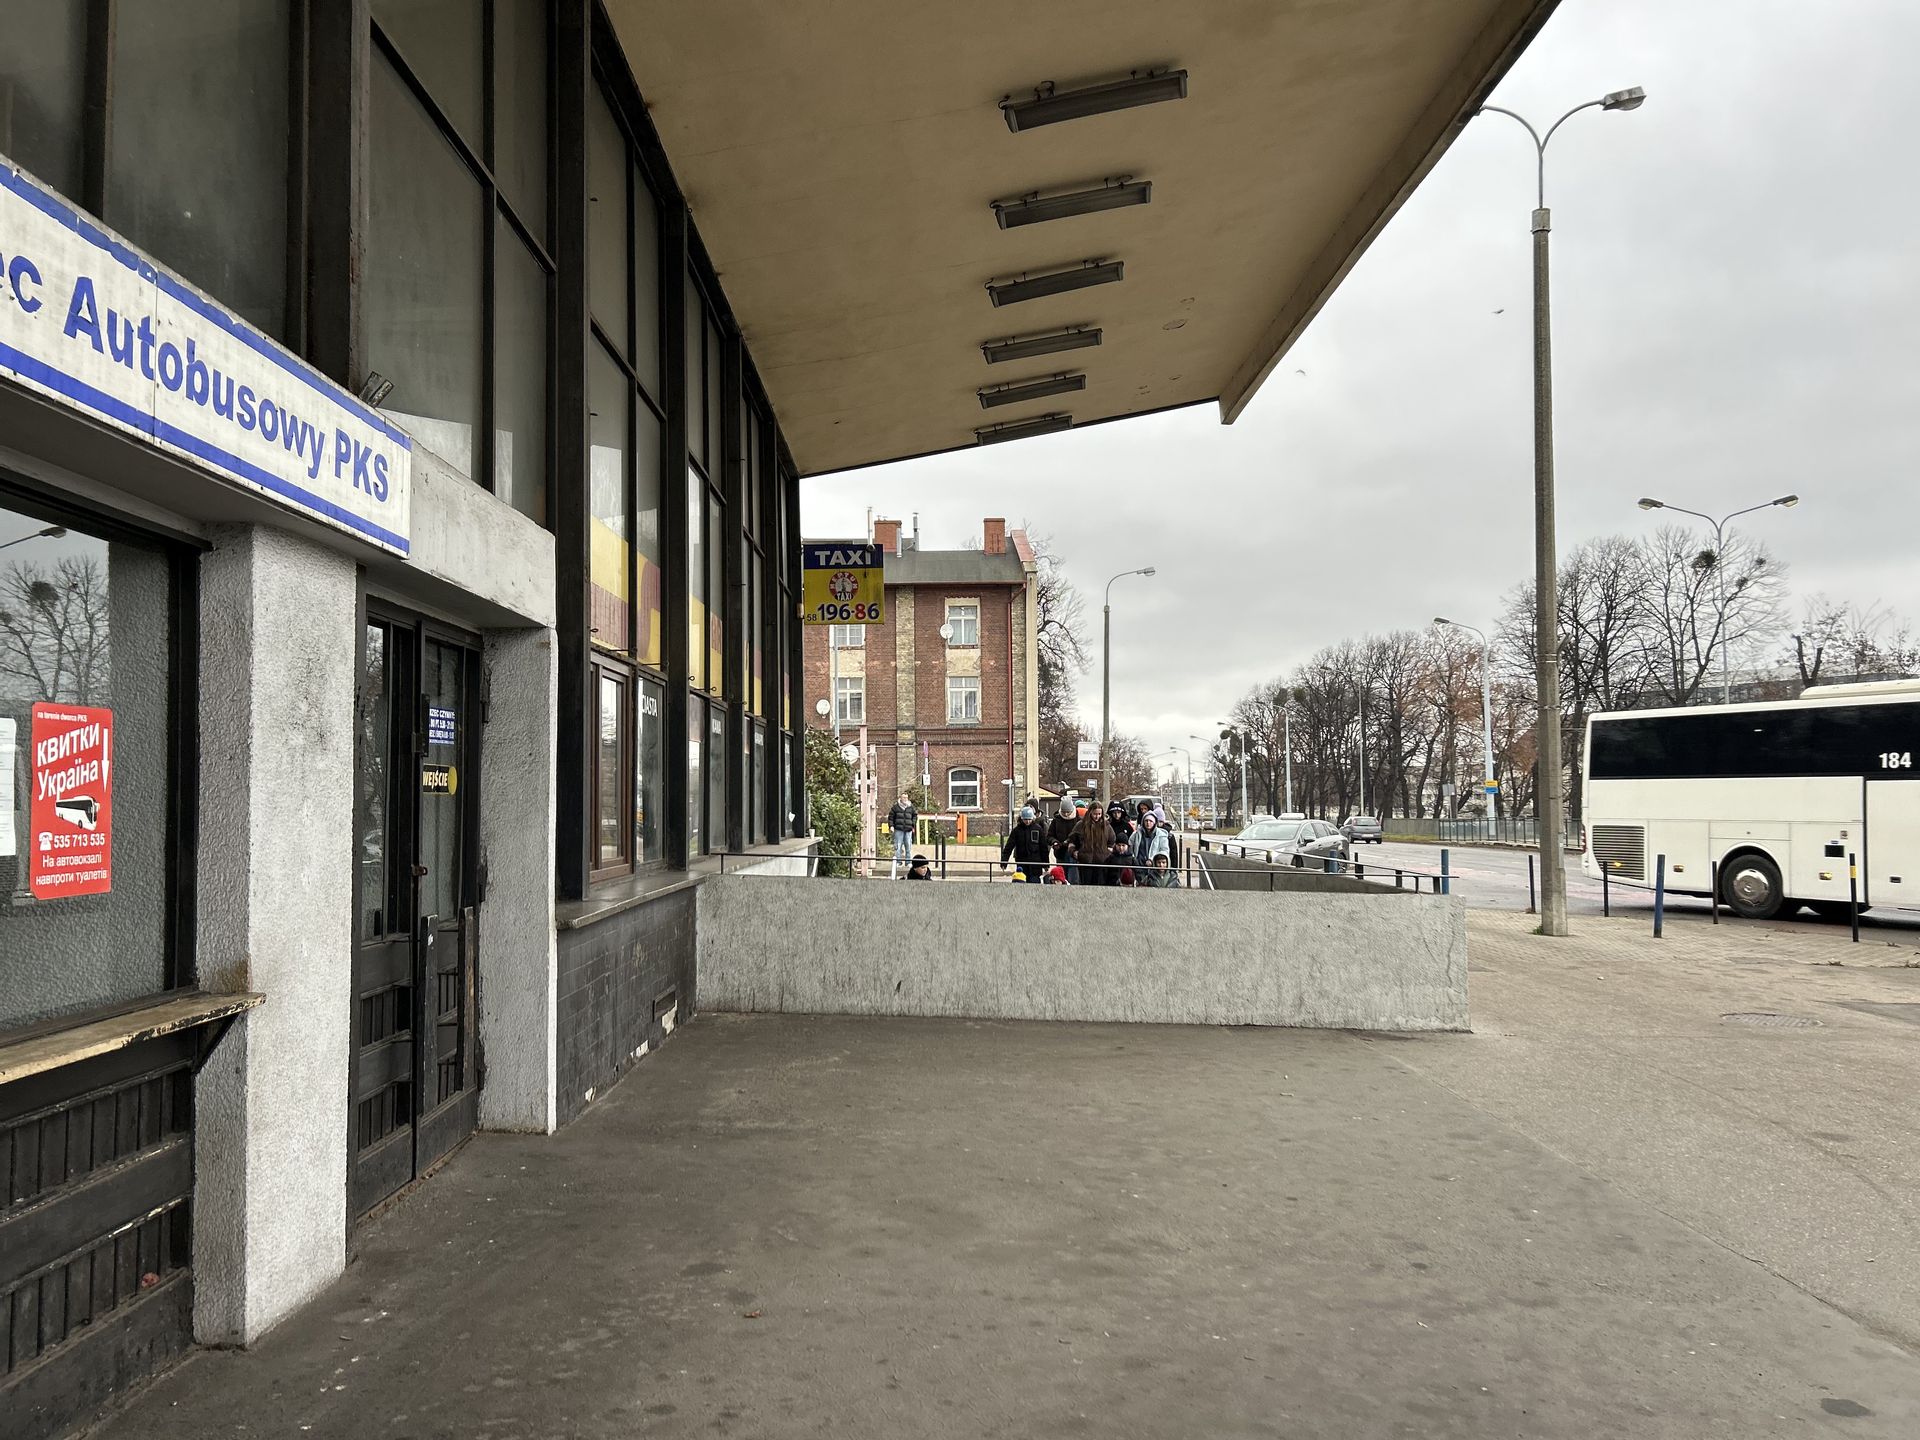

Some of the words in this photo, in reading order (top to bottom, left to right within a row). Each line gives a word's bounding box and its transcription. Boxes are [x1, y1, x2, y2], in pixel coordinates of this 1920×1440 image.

[63, 276, 326, 480] Autobusowy
[334, 427, 390, 503] PKS
[814, 550, 872, 566] TAXI
[829, 572, 858, 590] NEPTUN
[836, 592, 853, 602] TAXI
[806, 613, 817, 622] 58
[817, 603, 880, 621] 196-86
[77, 714, 88, 723] PKS
[37, 722, 100, 767] КВИТКИ
[1878, 752, 1912, 769] 184
[37, 758, 99, 801] Україна
[422, 769, 448, 790] WEJŚCIE
[53, 834, 71, 849] 535
[72, 834, 88, 847] 713
[89, 833, 106, 847] 535
[42, 854, 55, 868] На
[56, 851, 102, 866] автовокзалі
[35, 871, 75, 886] навпроти
[75, 867, 108, 884] туалетів
